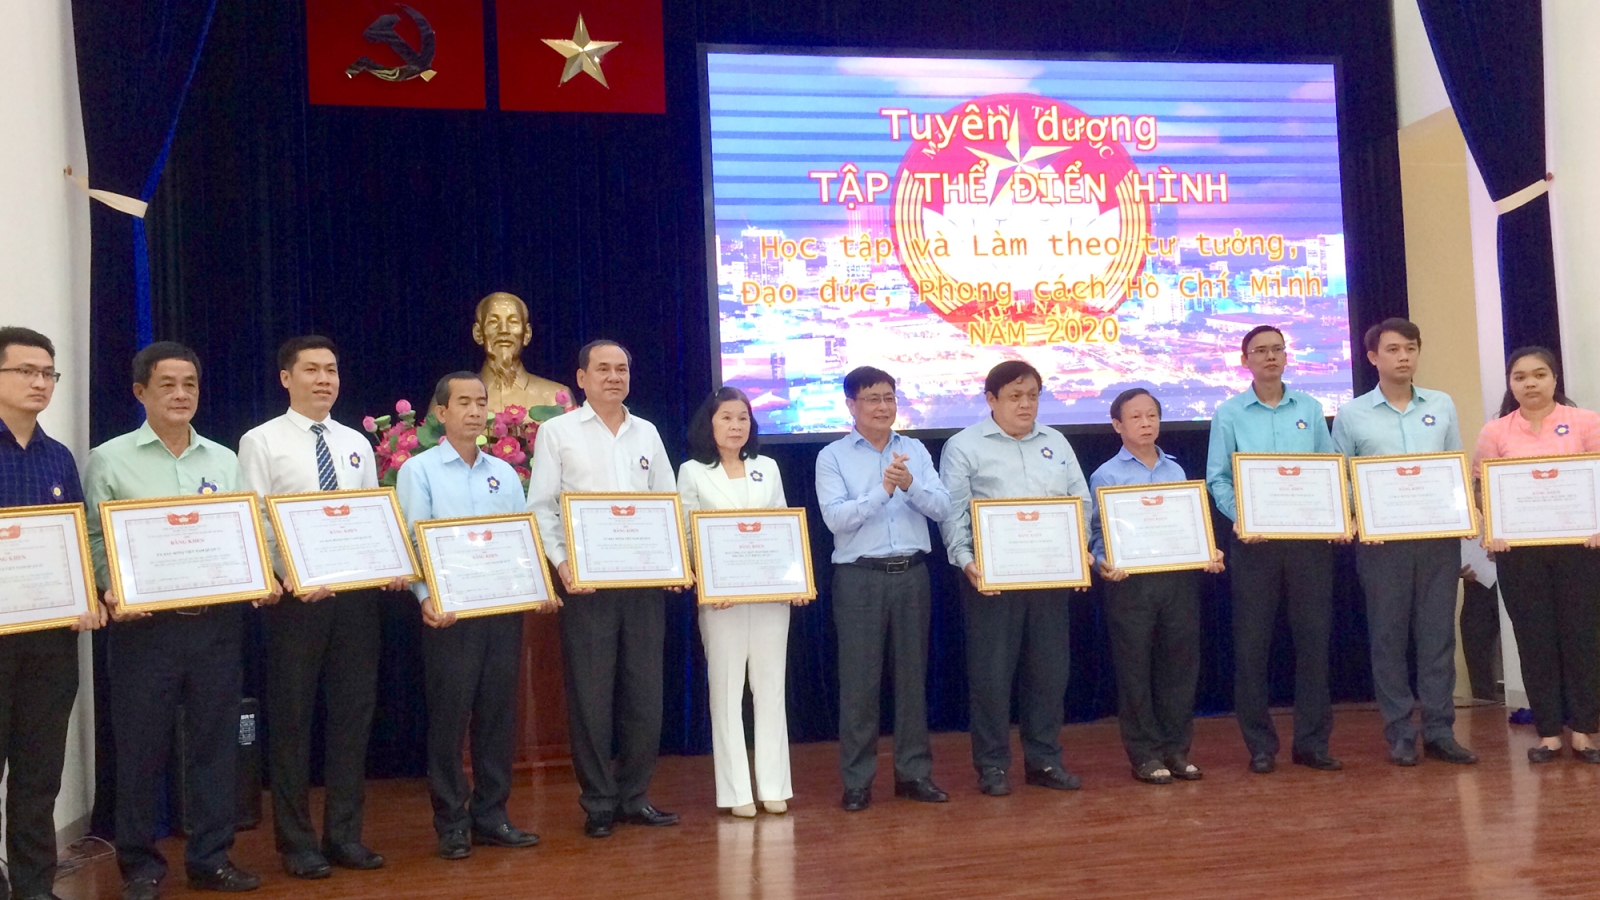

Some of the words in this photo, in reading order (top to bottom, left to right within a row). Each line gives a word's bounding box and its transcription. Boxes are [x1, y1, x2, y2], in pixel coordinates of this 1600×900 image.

[880, 104, 1010, 149] Tuyên
[809, 163, 890, 210] TẬP
[914, 159, 988, 203] THỂ
[1011, 161, 1107, 203] ĐIỂN
[1132, 165, 1229, 203] HÌNH
[761, 235, 817, 262] Học
[840, 234, 892, 263] tập
[913, 230, 951, 257] và
[973, 230, 1028, 256] Làm
[1048, 230, 1121, 256] theo
[1142, 234, 1176, 255] tư
[1196, 230, 1297, 260] tưởng,
[741, 281, 797, 307] Đạo
[819, 276, 891, 306] đức,
[919, 275, 1012, 307] Phong
[1034, 273, 1106, 300] cách
[1127, 273, 1159, 298] Hồ
[1179, 271, 1229, 298] Chí
[1251, 270, 1322, 297] Minh
[1047, 317, 1119, 343] 2020
